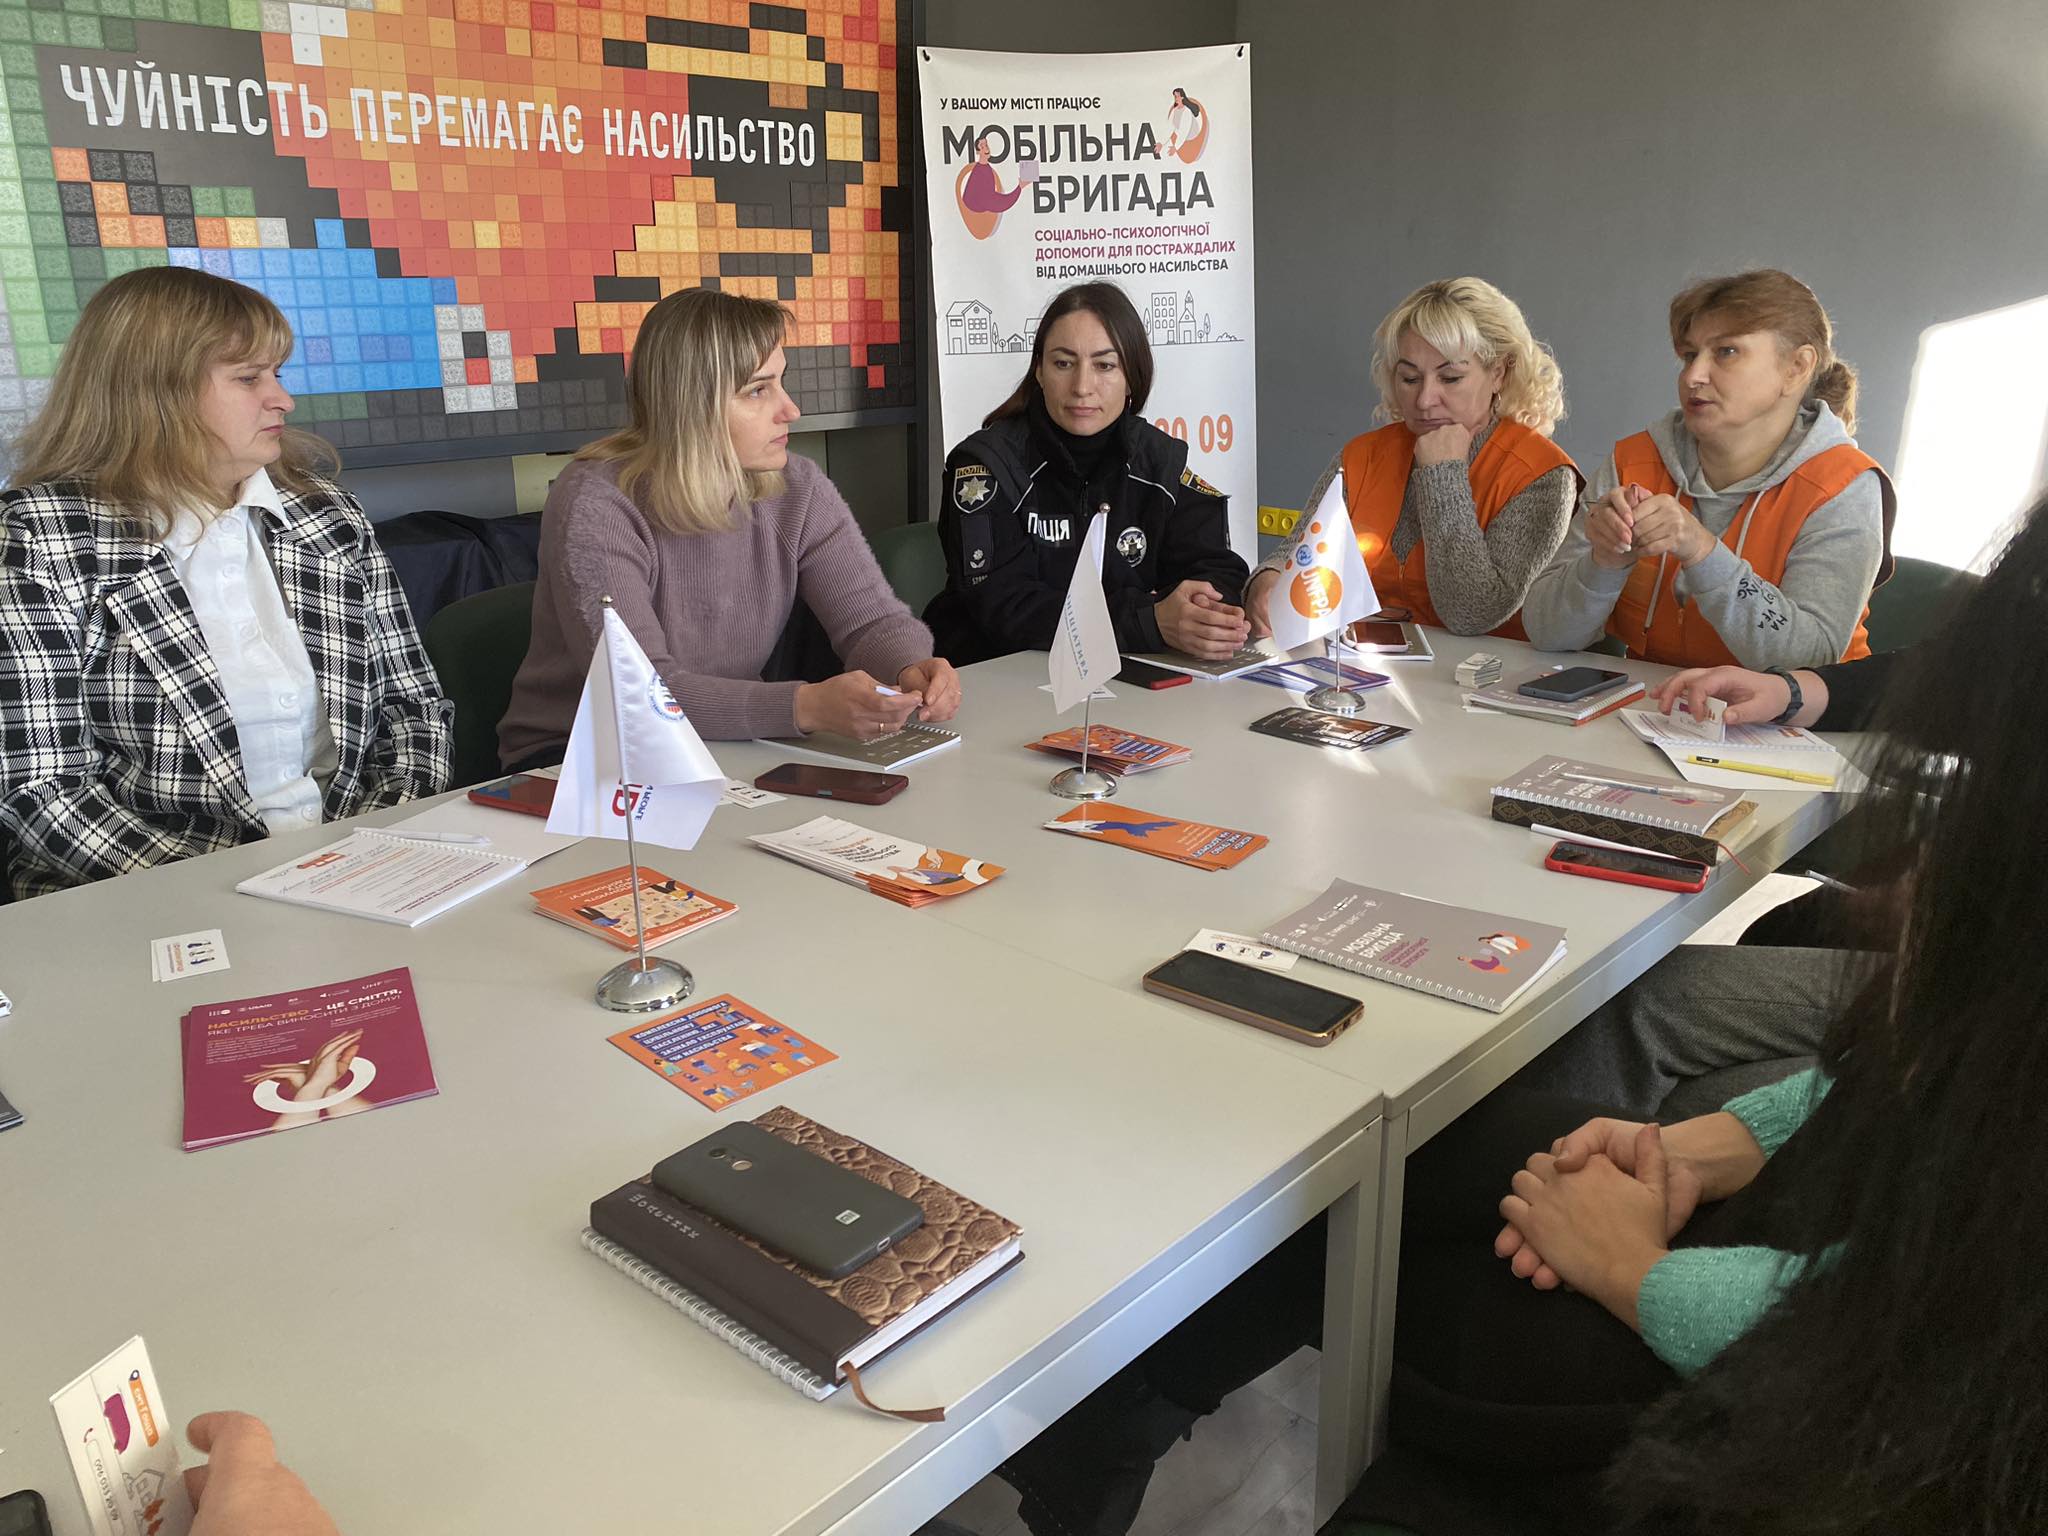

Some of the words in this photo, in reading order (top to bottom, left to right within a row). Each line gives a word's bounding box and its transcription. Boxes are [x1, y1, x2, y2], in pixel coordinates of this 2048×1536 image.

[60, 61, 329, 139] ЧУЙНІСТЬ
[350, 87, 585, 155] ПЕРЕМАГАЄ
[603, 107, 817, 168] НАСИЛЬСТВО
[940, 98, 948, 110] У
[951, 97, 1007, 110] ВАШОМУ
[1010, 97, 1044, 111] МІСТІ
[1047, 96, 1101, 111] ПРАЦЮЄ
[942, 122, 1162, 165] МОБІЛЬНА
[1032, 171, 1215, 217] БРИГАДА
[1034, 222, 1210, 243] СОЦІАЛЬНО-ПСИХОЛОГІЧНОЇ
[1035, 247, 1105, 262] ДОПОМОГИ
[1108, 246, 1133, 259] ДЛЯ
[1135, 241, 1236, 257] ПОСТРАЖДАЛИХ
[1036, 265, 1057, 280] ВІД
[1059, 262, 1147, 279] ДОМАШНЬОГО
[1149, 258, 1229, 274] НАСИЛЬСТВА
[1199, 414, 1234, 454] 09
[1299, 568, 1333, 618] UNFPA
[207, 1009, 310, 1030] НАСИЛЬСТВО
[326, 1001, 346, 1012] ЦЕ
[347, 989, 403, 1005] СМІТТЯ,
[207, 1028, 232, 1036] ЯКЕ
[235, 1022, 274, 1032] ТРЕБА
[277, 1007, 349, 1026] ВИНОСИТИ
